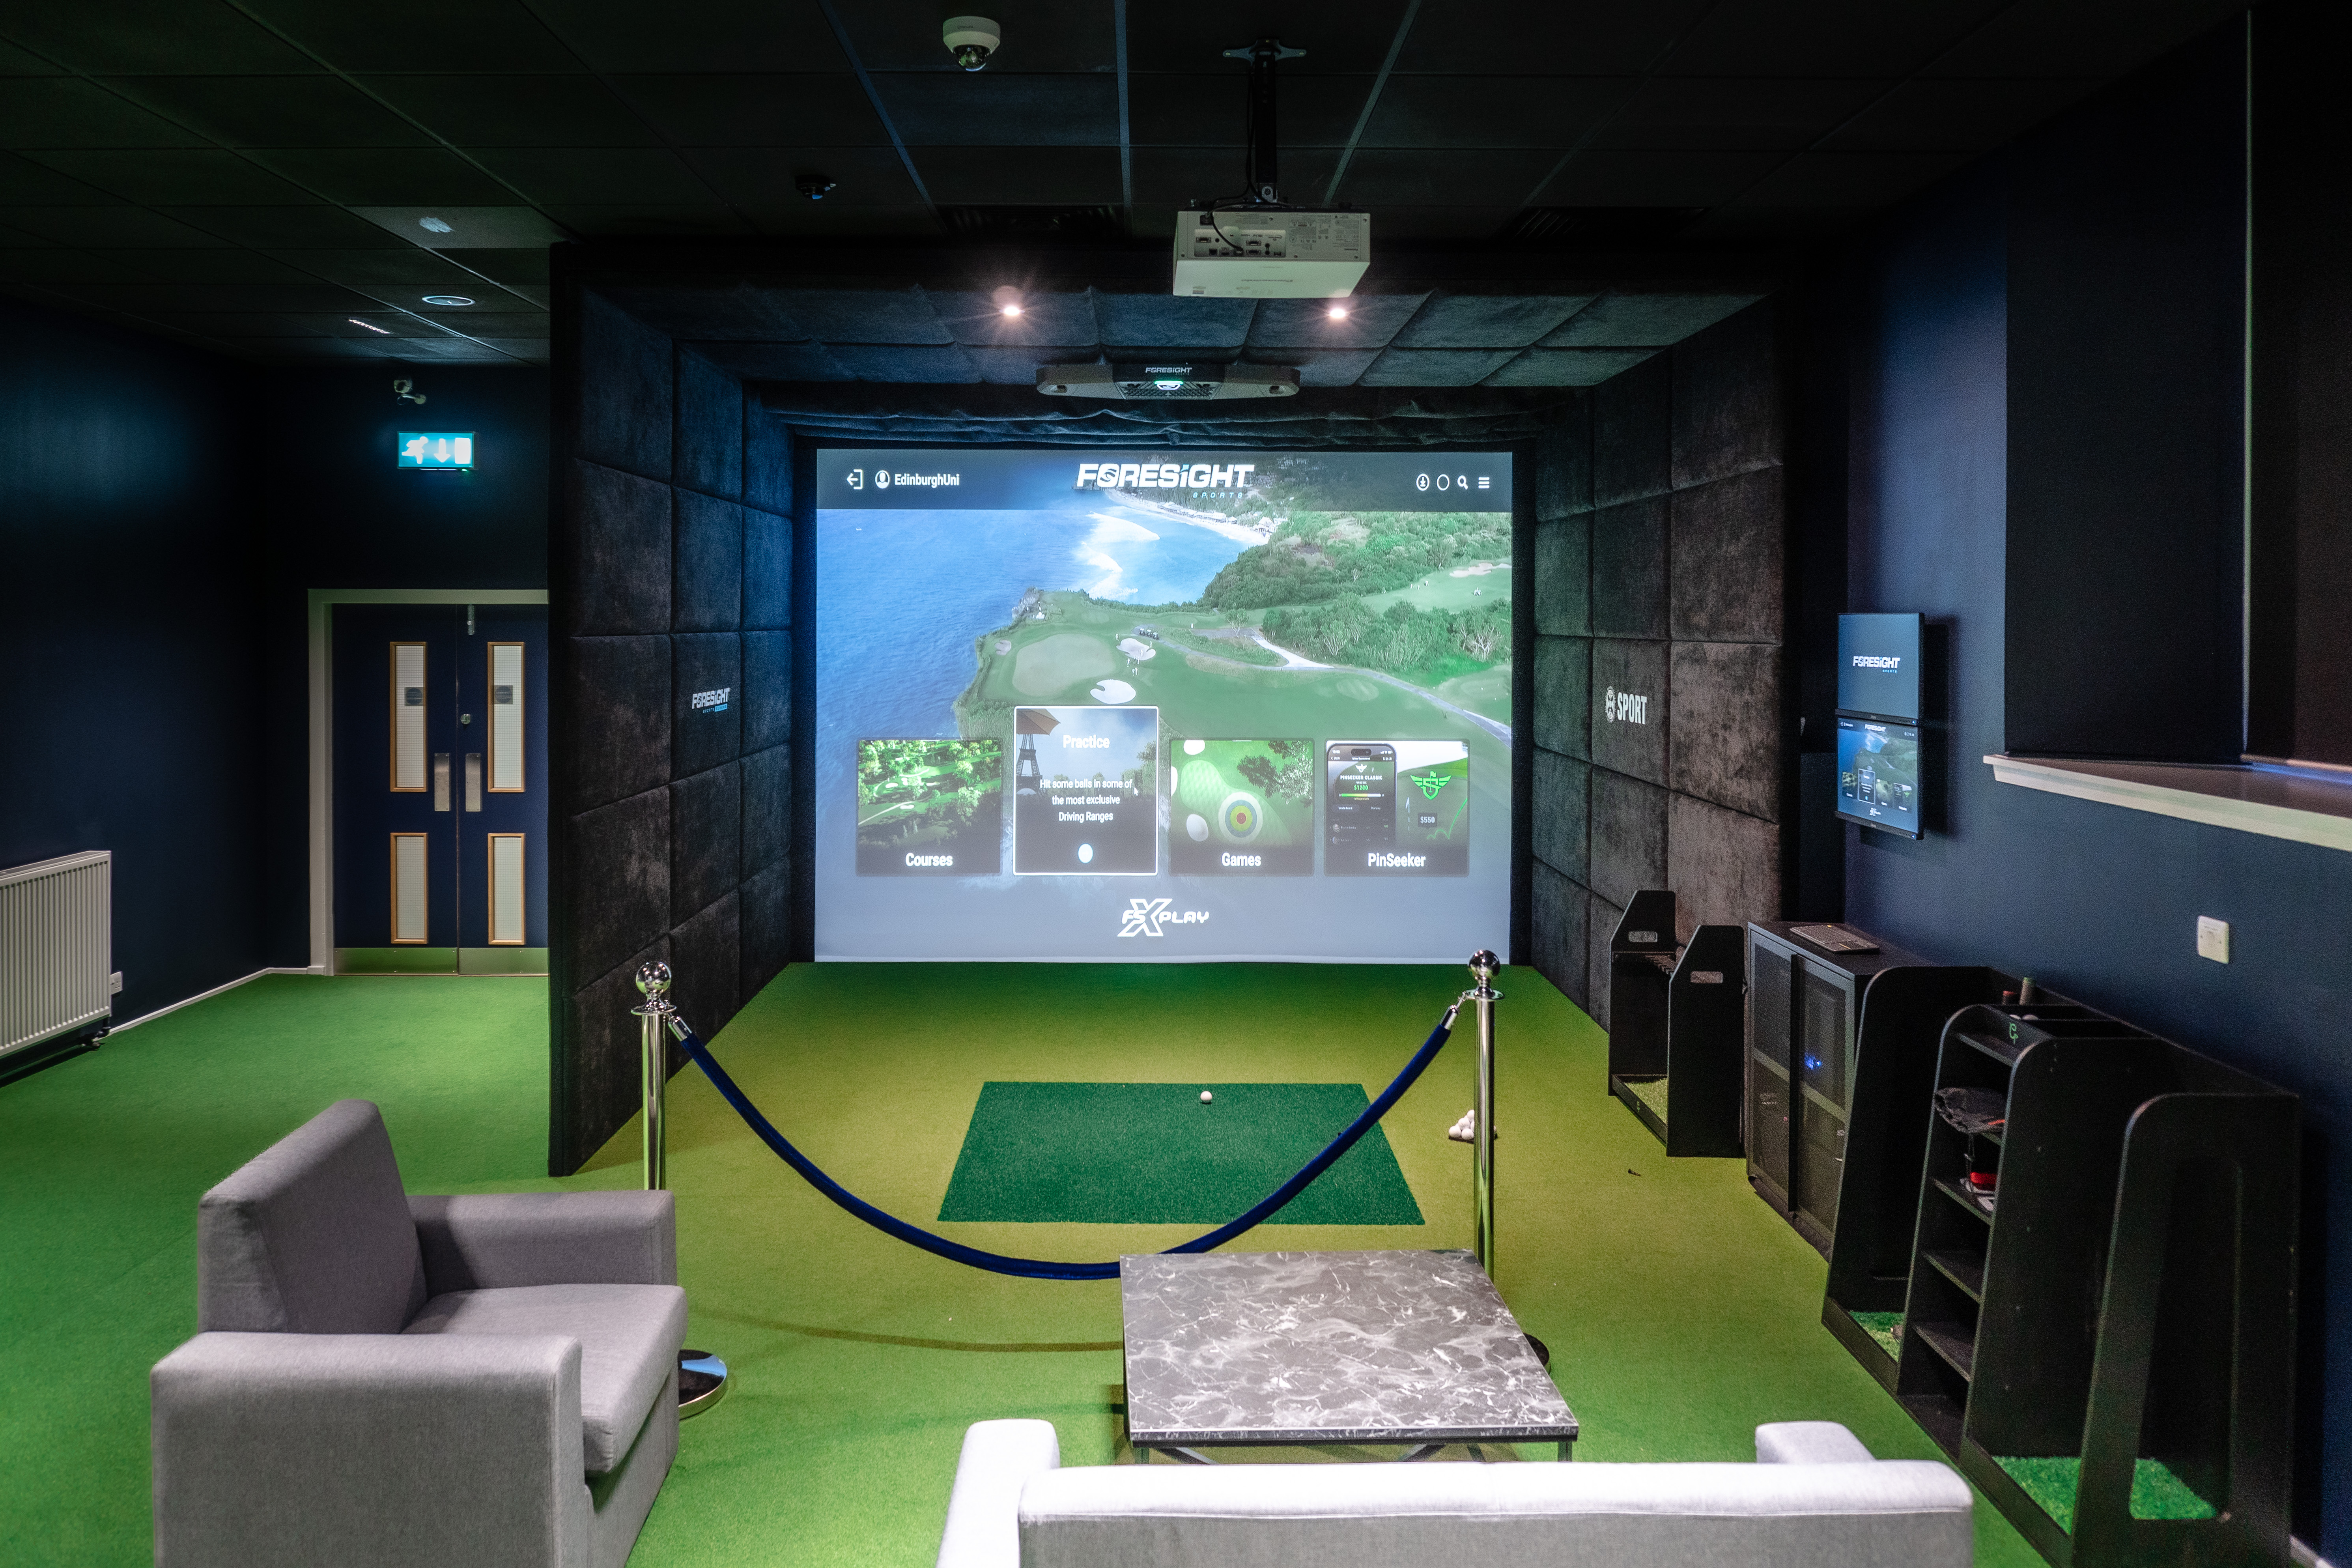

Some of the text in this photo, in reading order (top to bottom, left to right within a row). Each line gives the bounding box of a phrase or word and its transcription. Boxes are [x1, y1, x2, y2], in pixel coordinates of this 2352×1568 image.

[894, 473, 960, 488] EdinburghUni
[1617, 692, 1648, 725] SPORT
[1063, 734, 1110, 749] Practice
[1039, 779, 1051, 789] Hit
[1052, 780, 1073, 789] some
[1074, 779, 1093, 788] balls
[1094, 779, 1101, 788] in
[1124, 779, 1133, 788] of
[1052, 794, 1121, 805] the most exclusive
[1058, 811, 1114, 823] Driving Ranges
[1420, 816, 1435, 824] $550
[905, 852, 953, 867] Courses
[1221, 852, 1262, 867] Games
[1367, 852, 1426, 867] PinSeeker
[1158, 911, 1210, 924] PLAY
